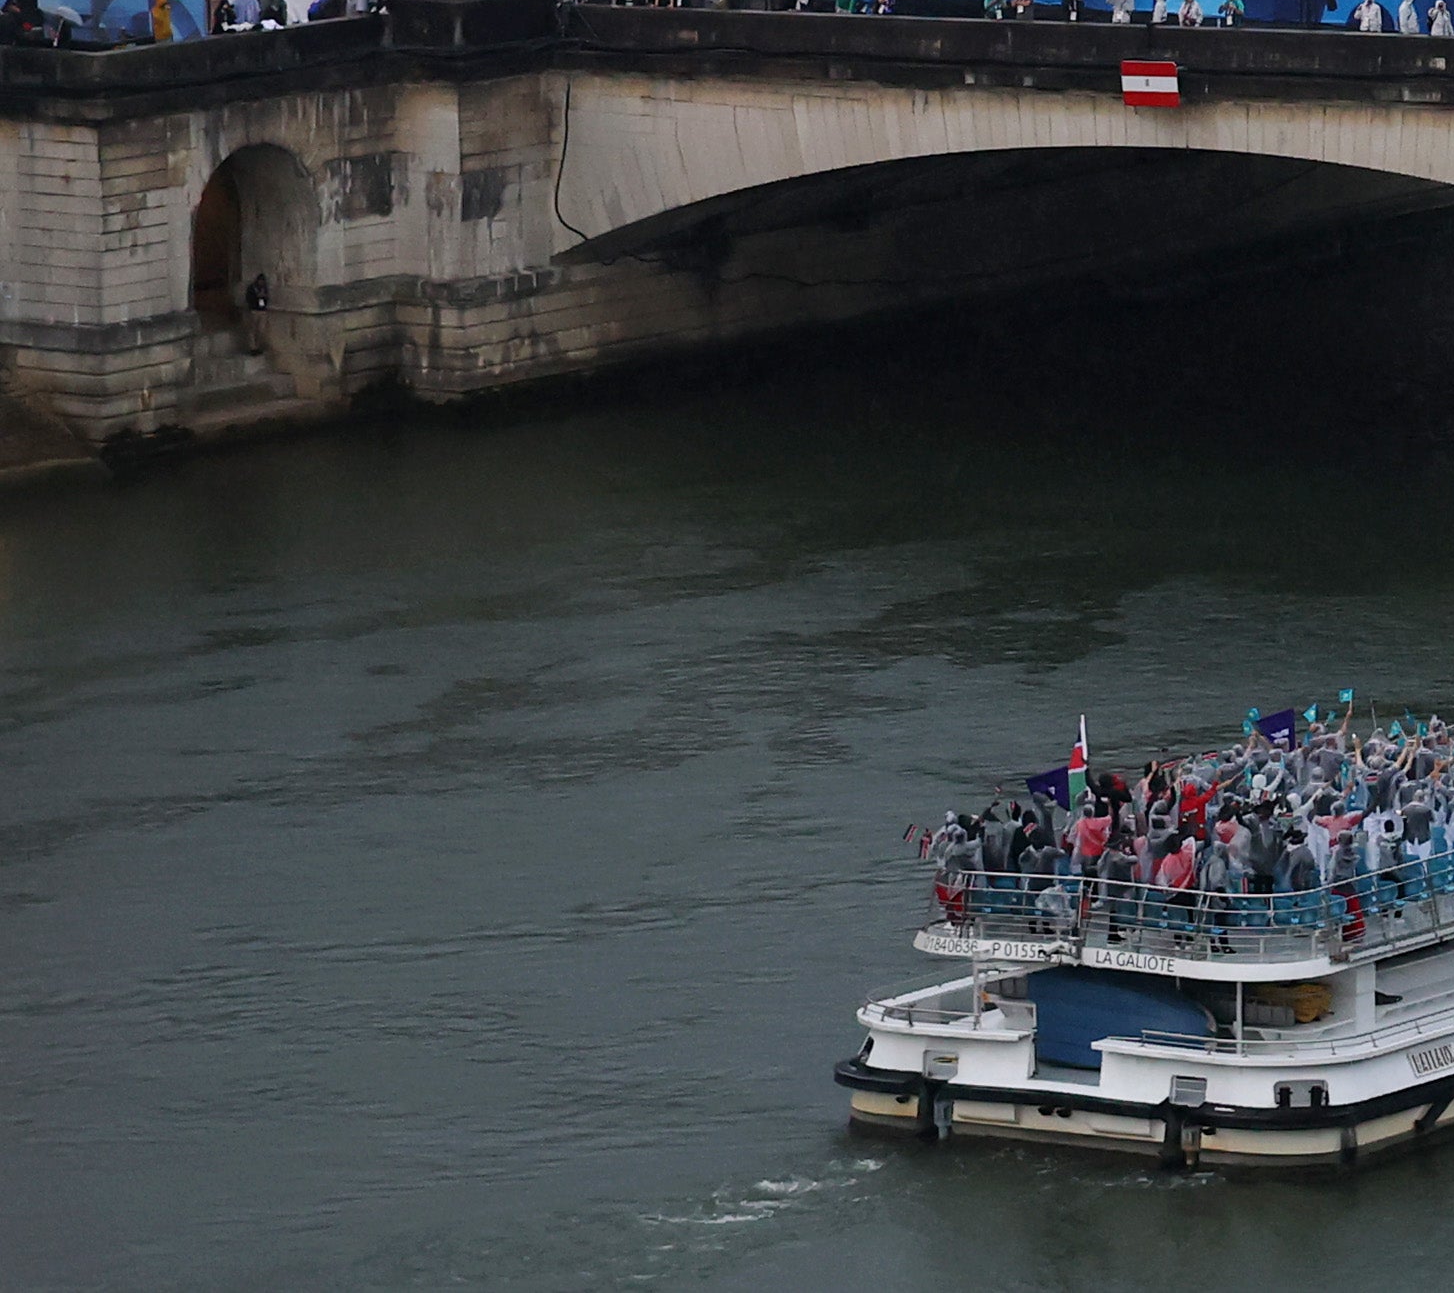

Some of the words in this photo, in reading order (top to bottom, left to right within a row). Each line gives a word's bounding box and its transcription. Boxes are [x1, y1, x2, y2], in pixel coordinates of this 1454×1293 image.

[992, 942, 1001, 956] P
[1096, 950, 1112, 965] LA
[1116, 952, 1175, 972] GALIOTE
